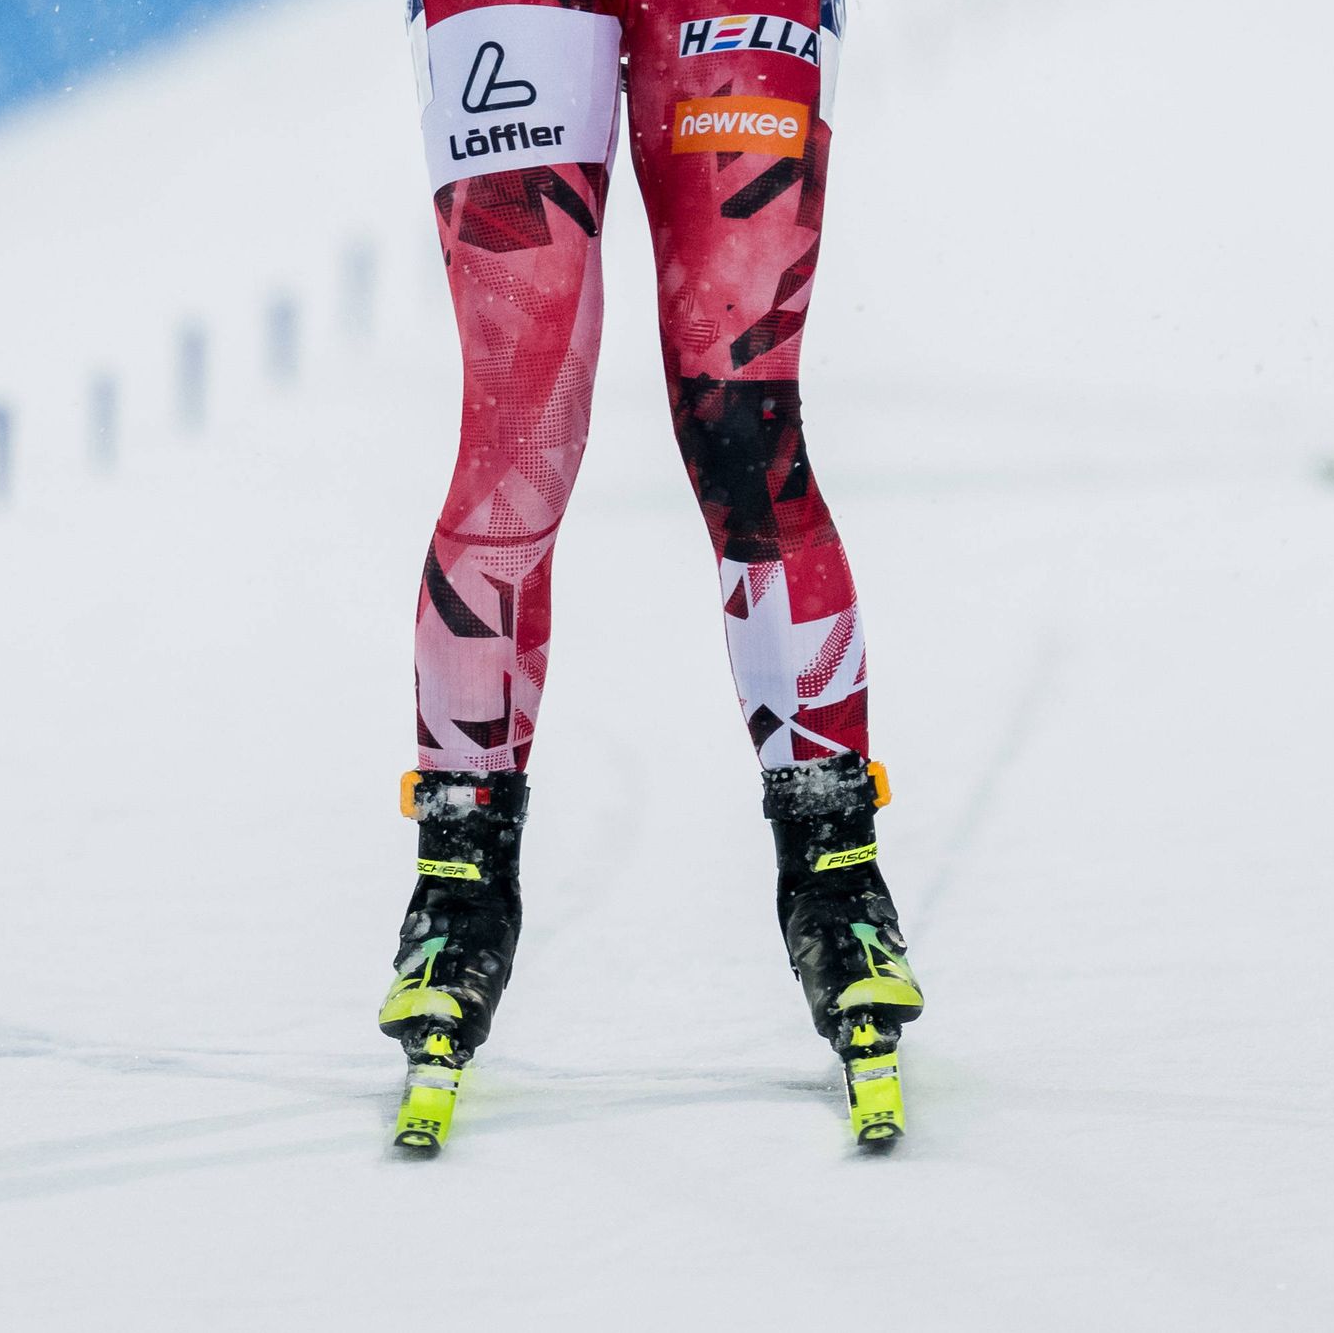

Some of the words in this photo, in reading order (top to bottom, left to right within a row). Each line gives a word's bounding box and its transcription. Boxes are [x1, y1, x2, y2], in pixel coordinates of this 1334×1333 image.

[680, 16, 819, 66] HELLA
[448, 122, 566, 161] Löffler
[679, 111, 799, 140] newkee
